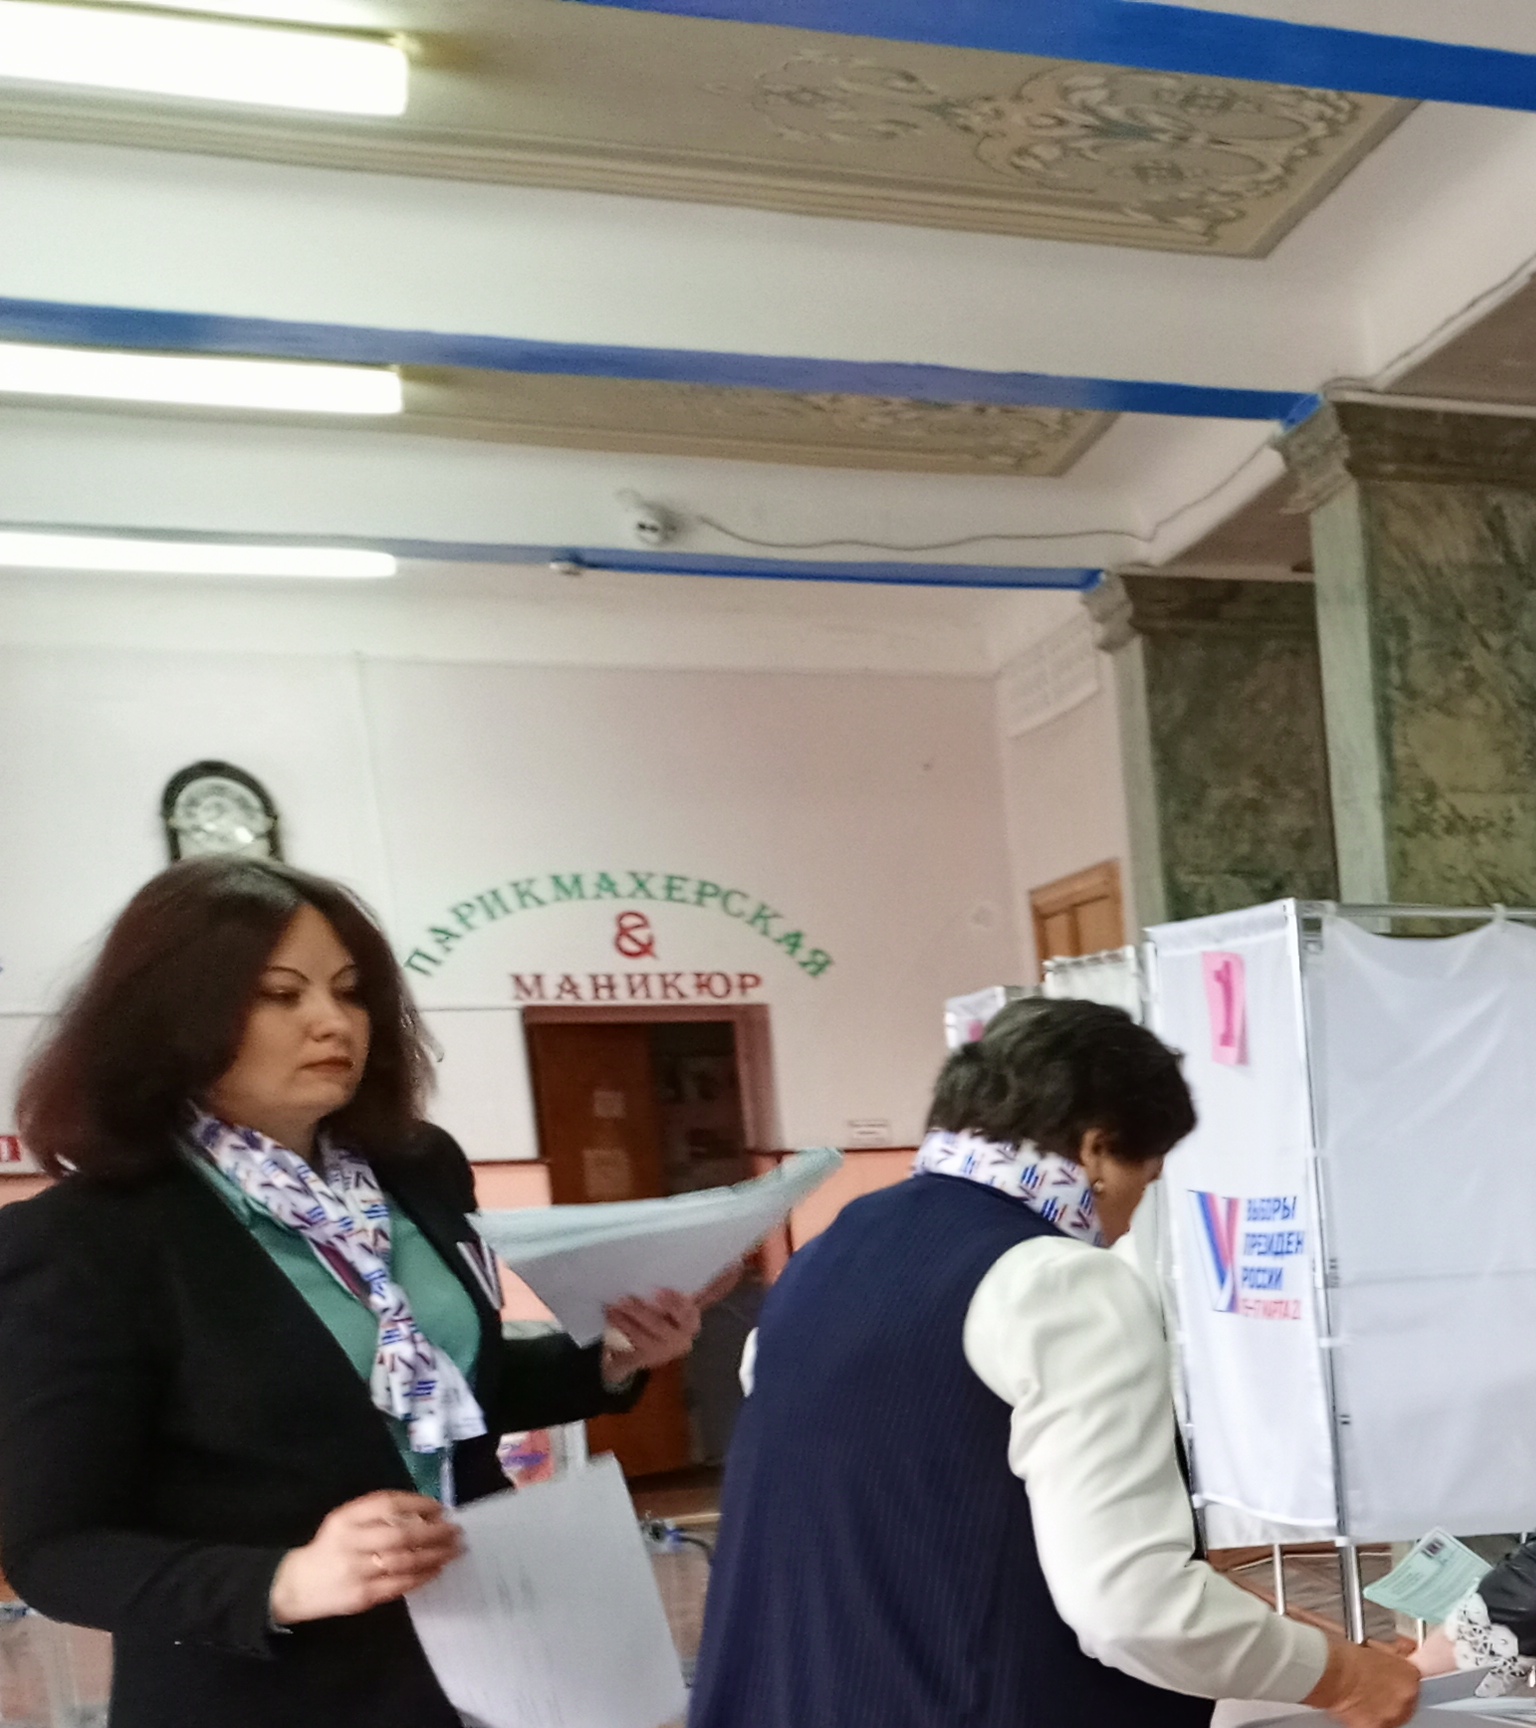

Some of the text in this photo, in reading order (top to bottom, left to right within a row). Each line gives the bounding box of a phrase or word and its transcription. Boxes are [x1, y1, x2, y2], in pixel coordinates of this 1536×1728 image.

[402, 870, 835, 979] ПАРИКМАХЕРСКАЯ
[509, 971, 763, 1001] МАНИКЮР
[1213, 960, 1235, 1047] 1
